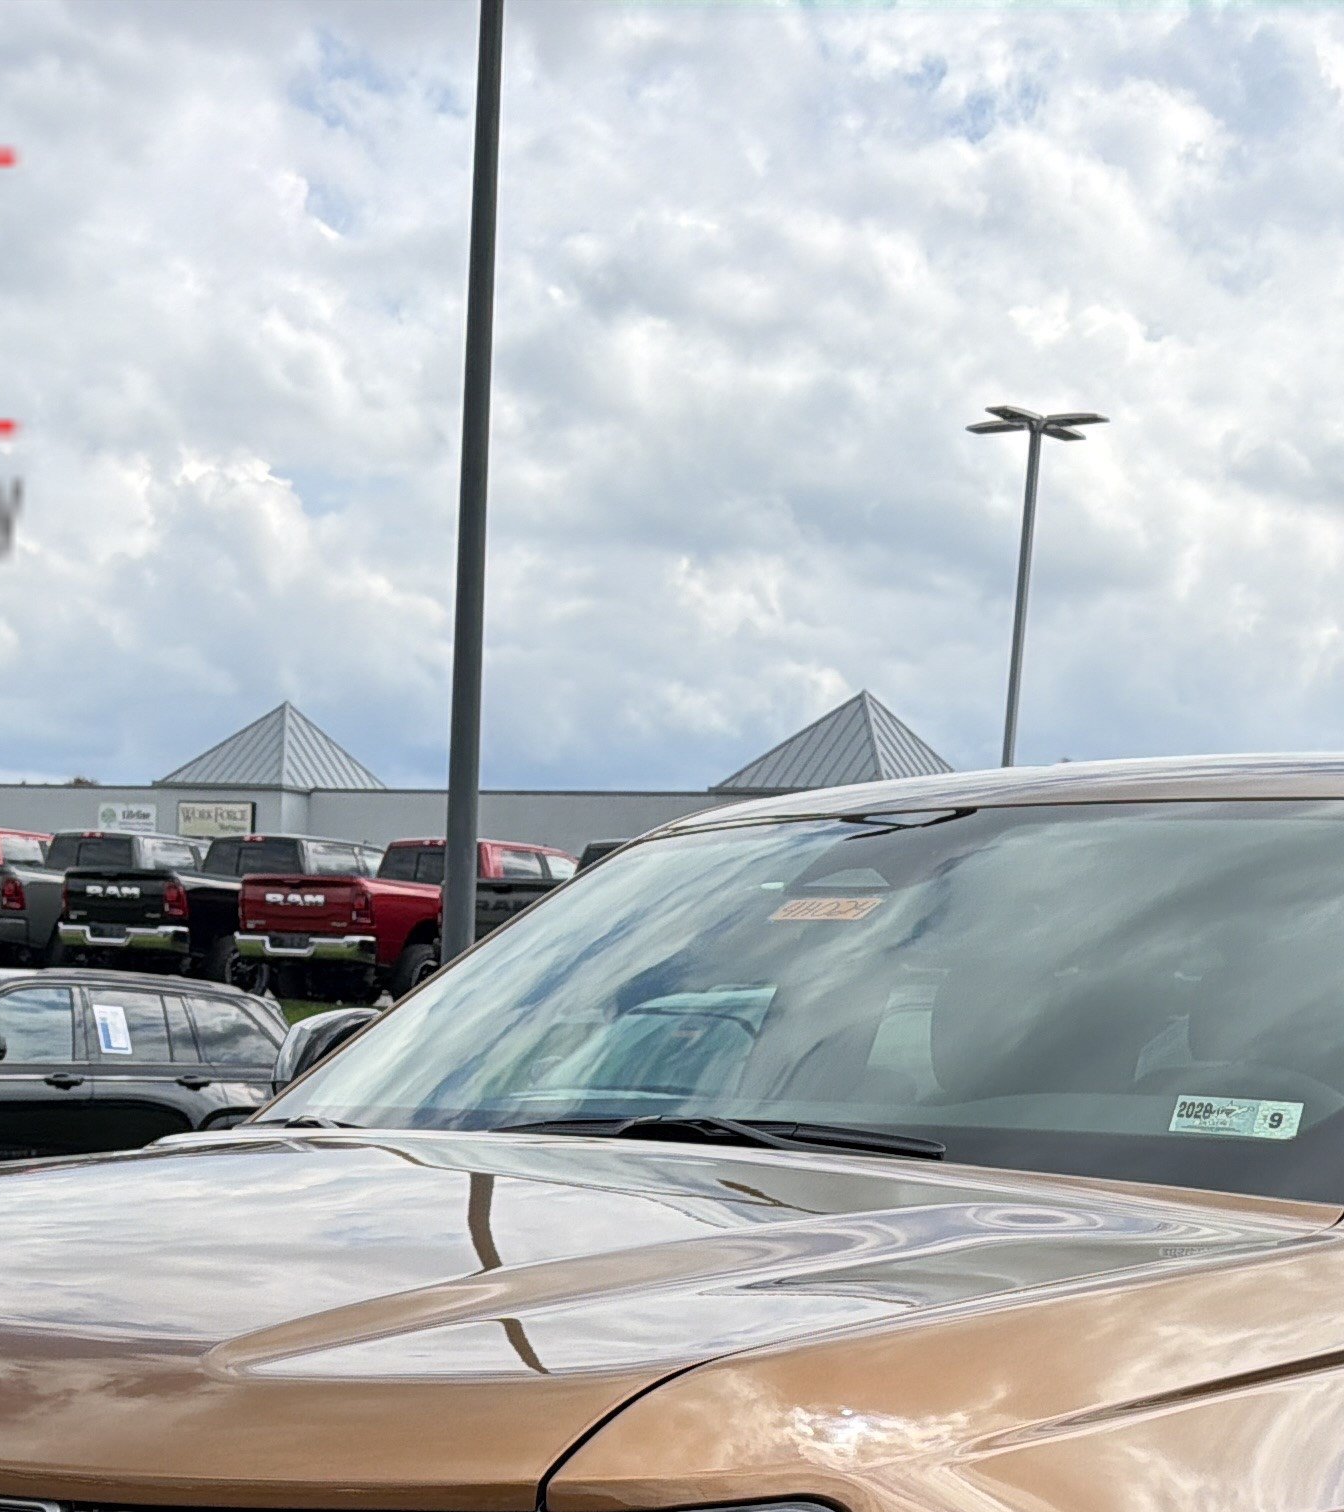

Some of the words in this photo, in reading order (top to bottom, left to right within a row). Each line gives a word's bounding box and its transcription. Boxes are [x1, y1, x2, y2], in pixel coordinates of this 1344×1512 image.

[85, 885, 141, 899] RAM
[265, 893, 325, 907] RAM
[1267, 1111, 1284, 1129] 9
